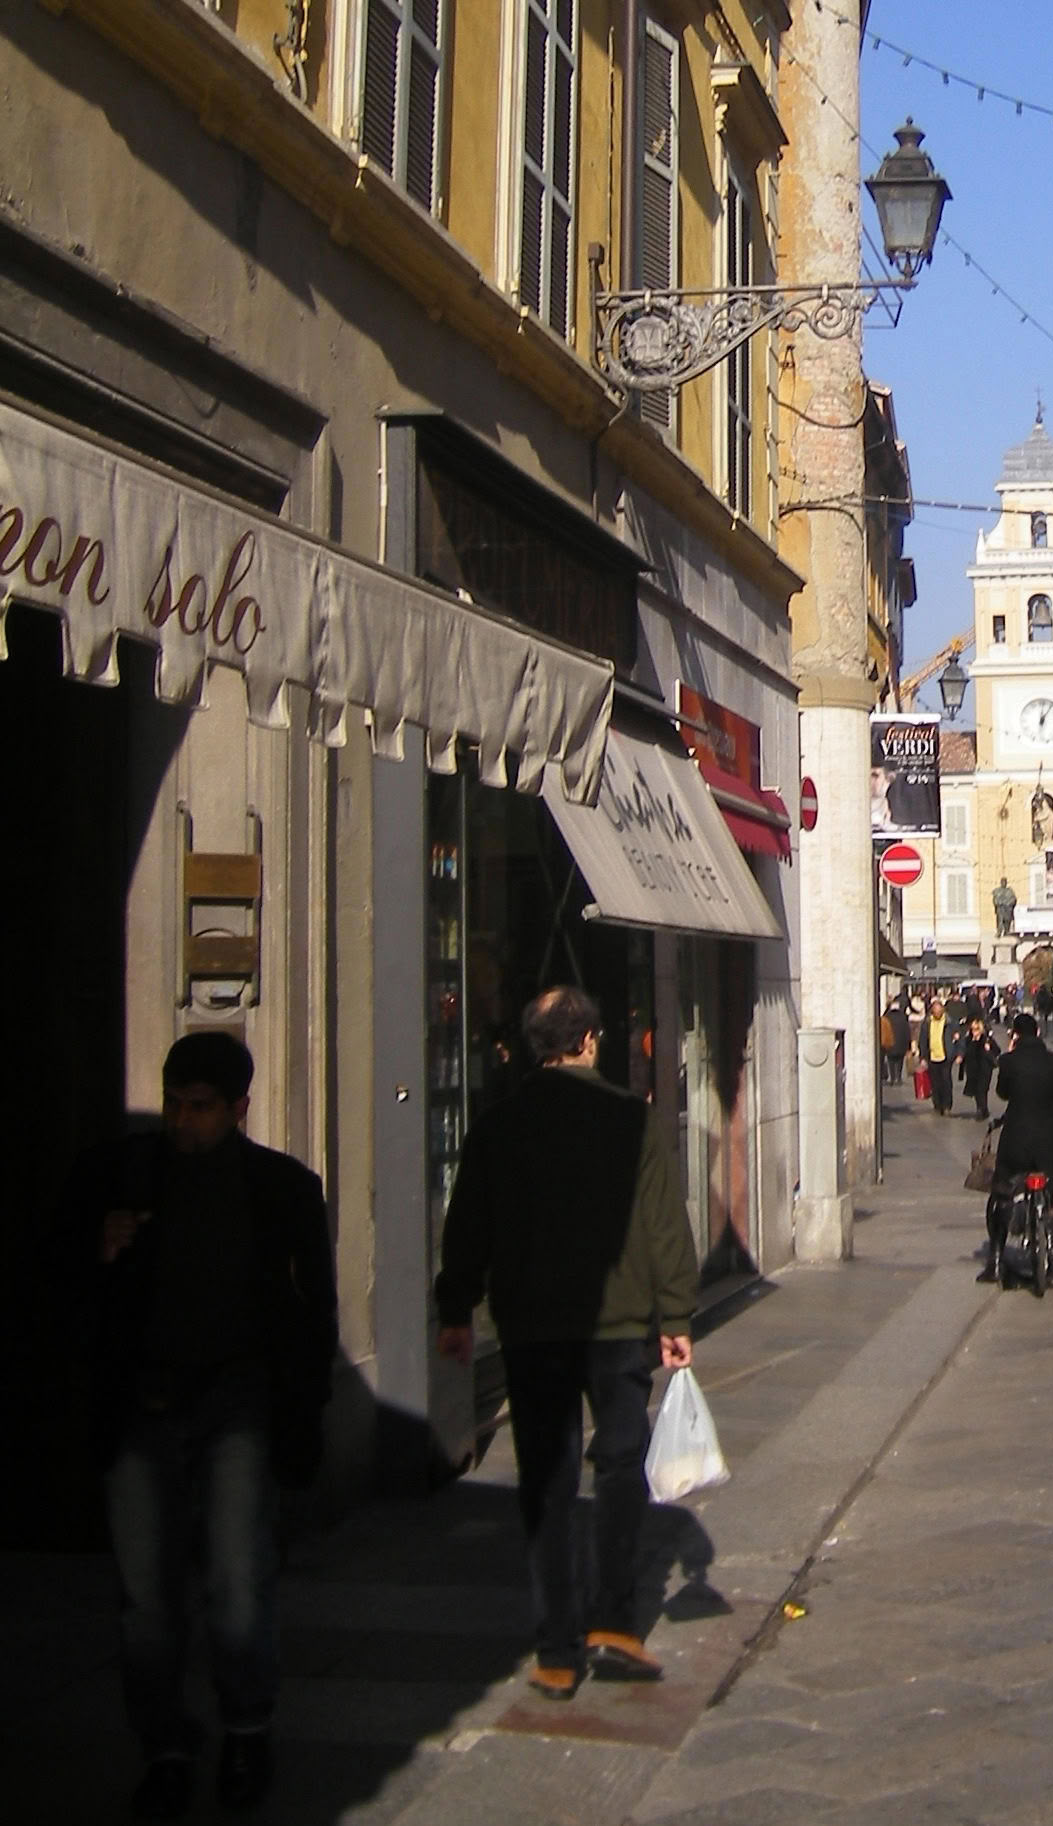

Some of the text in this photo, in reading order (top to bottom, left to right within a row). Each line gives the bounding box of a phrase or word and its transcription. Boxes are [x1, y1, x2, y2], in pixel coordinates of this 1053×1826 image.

[144, 529, 267, 654] solo
[885, 726, 936, 745] festival
[881, 739, 935, 755] VERDI
